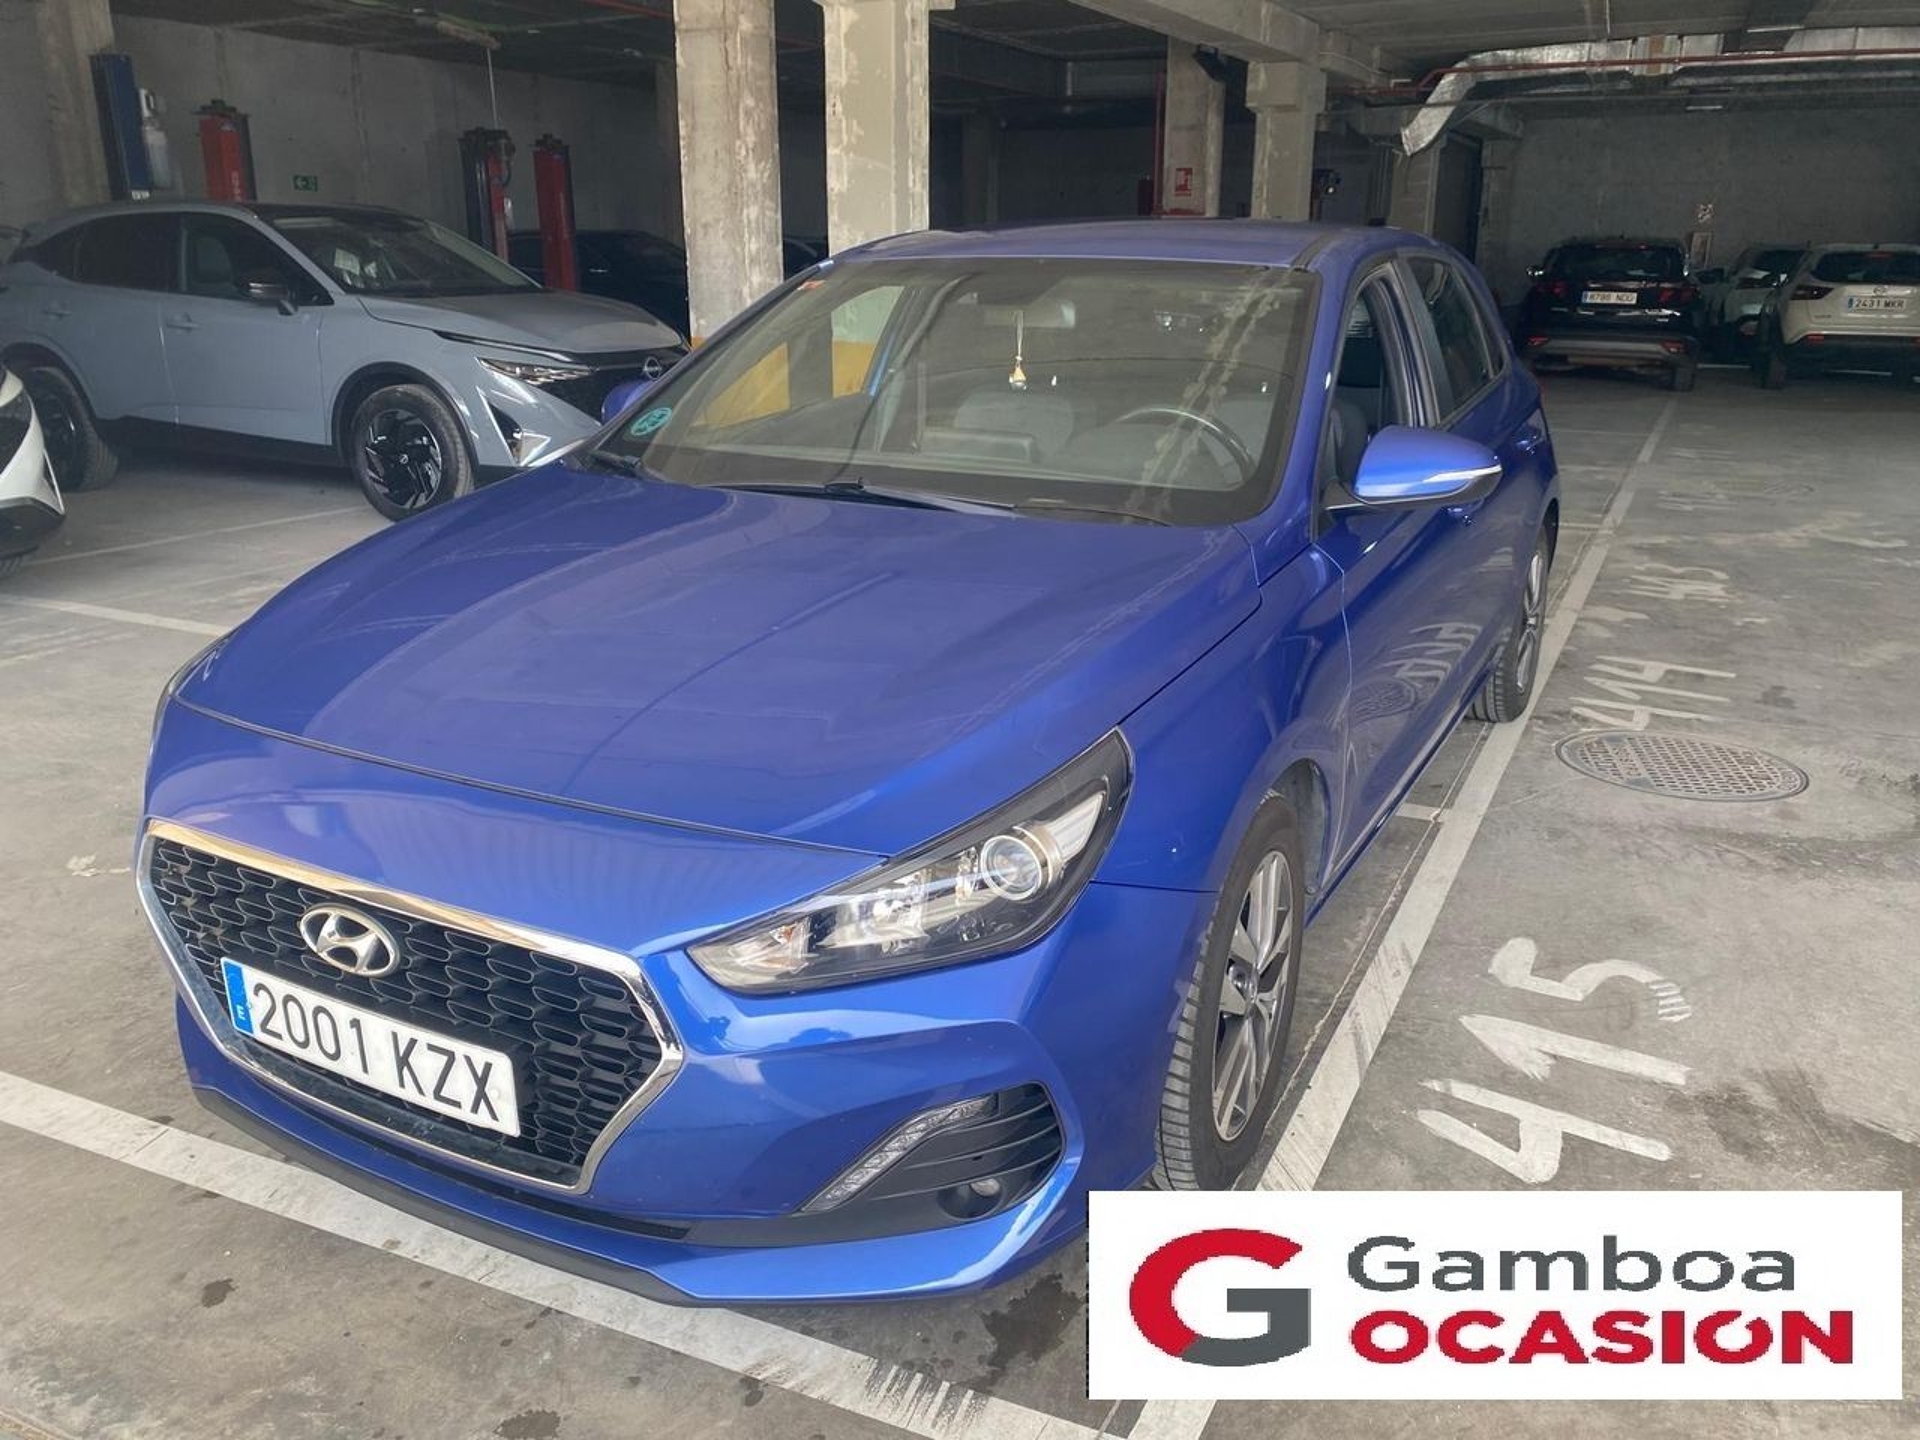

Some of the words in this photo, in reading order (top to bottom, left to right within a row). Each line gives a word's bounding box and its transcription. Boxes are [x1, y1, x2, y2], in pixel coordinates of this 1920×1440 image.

[1569, 655, 1737, 731] 414
[236, 1003, 246, 1021] E
[253, 981, 369, 1076] 2001
[391, 1030, 500, 1122] KZX
[1416, 937, 1694, 1183] 415
